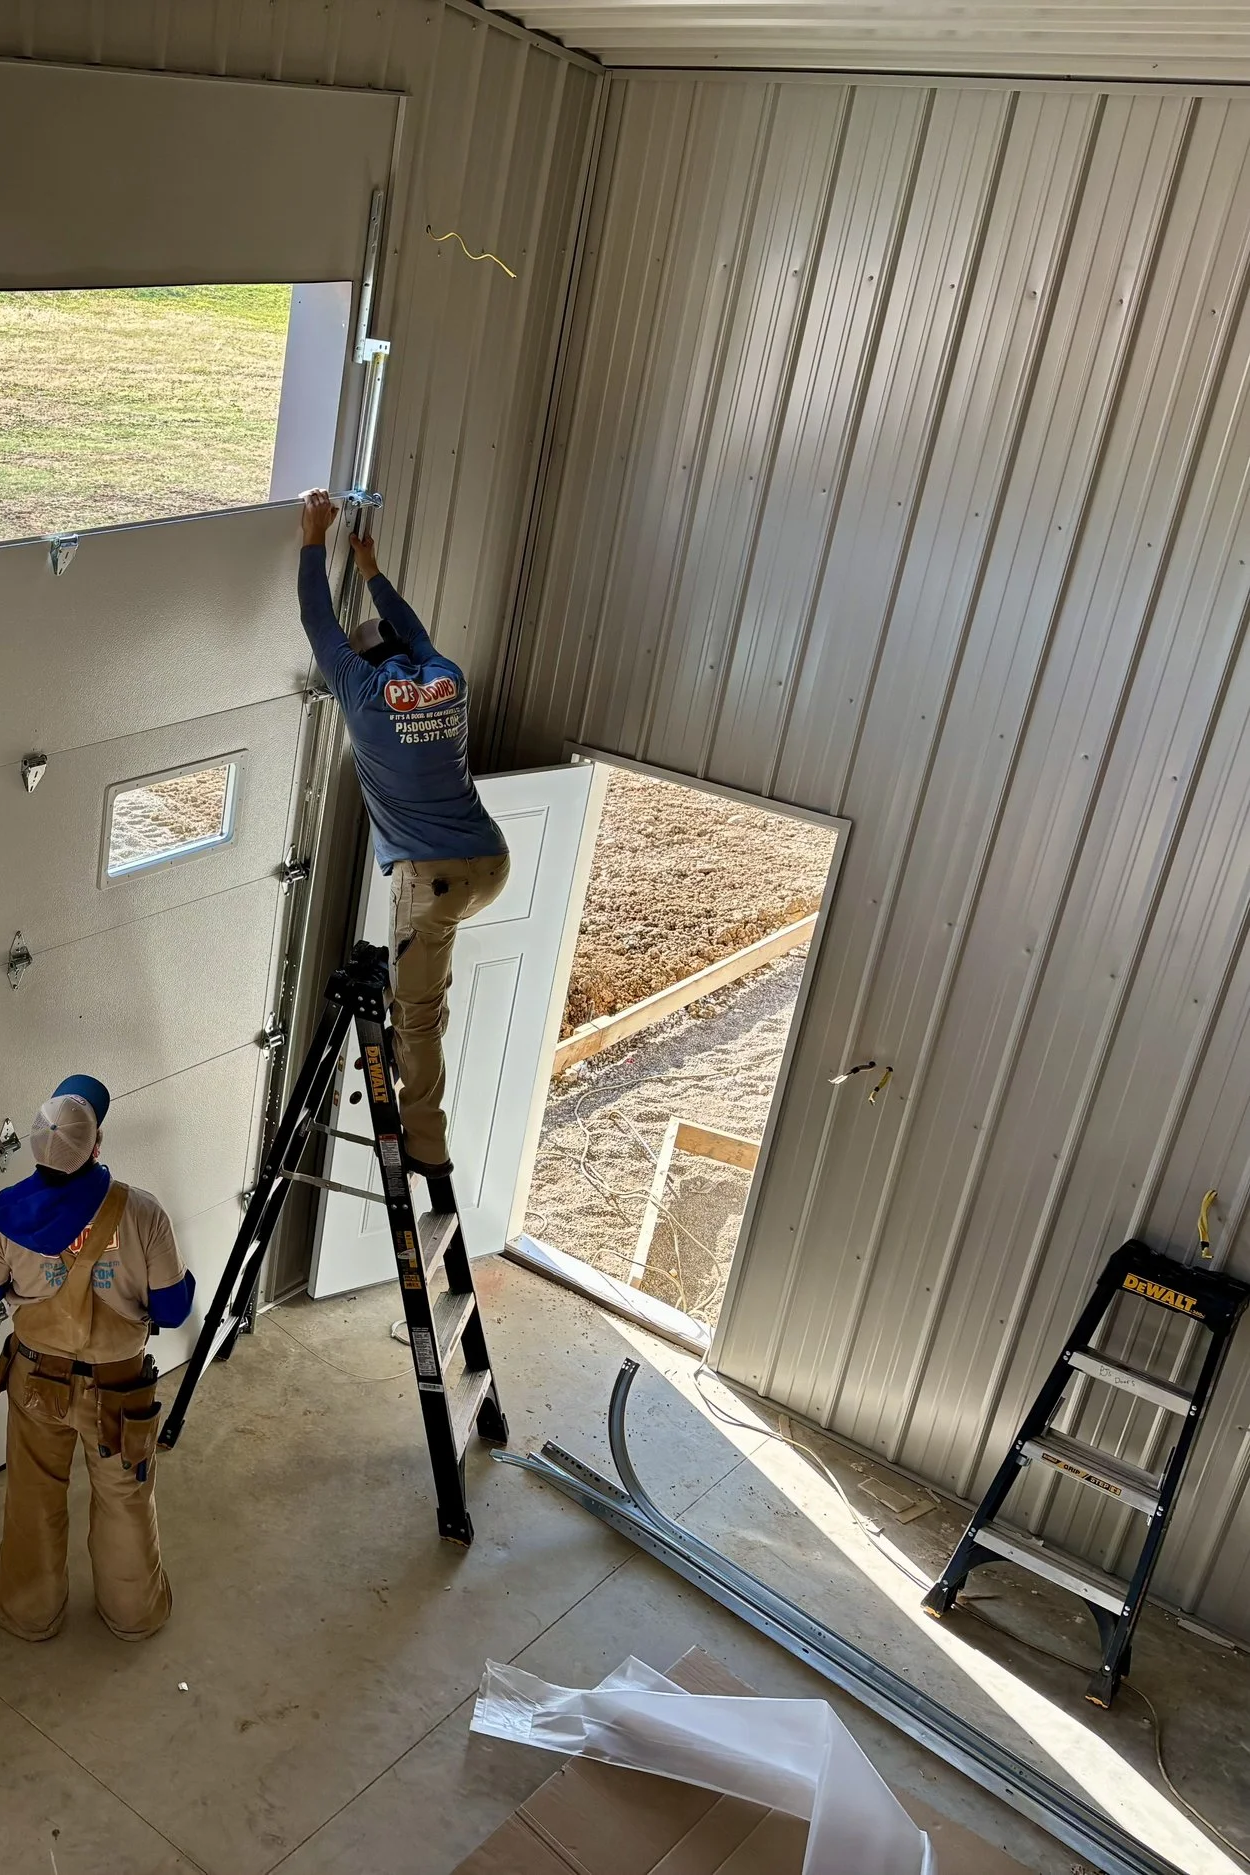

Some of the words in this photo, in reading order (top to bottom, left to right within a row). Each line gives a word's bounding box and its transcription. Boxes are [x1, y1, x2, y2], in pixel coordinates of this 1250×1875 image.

[389, 685, 415, 704] PJ's
[419, 680, 454, 703] DOORS
[1063, 1464, 1080, 1475] GRIP
[1090, 1476, 1109, 1490] STEP
